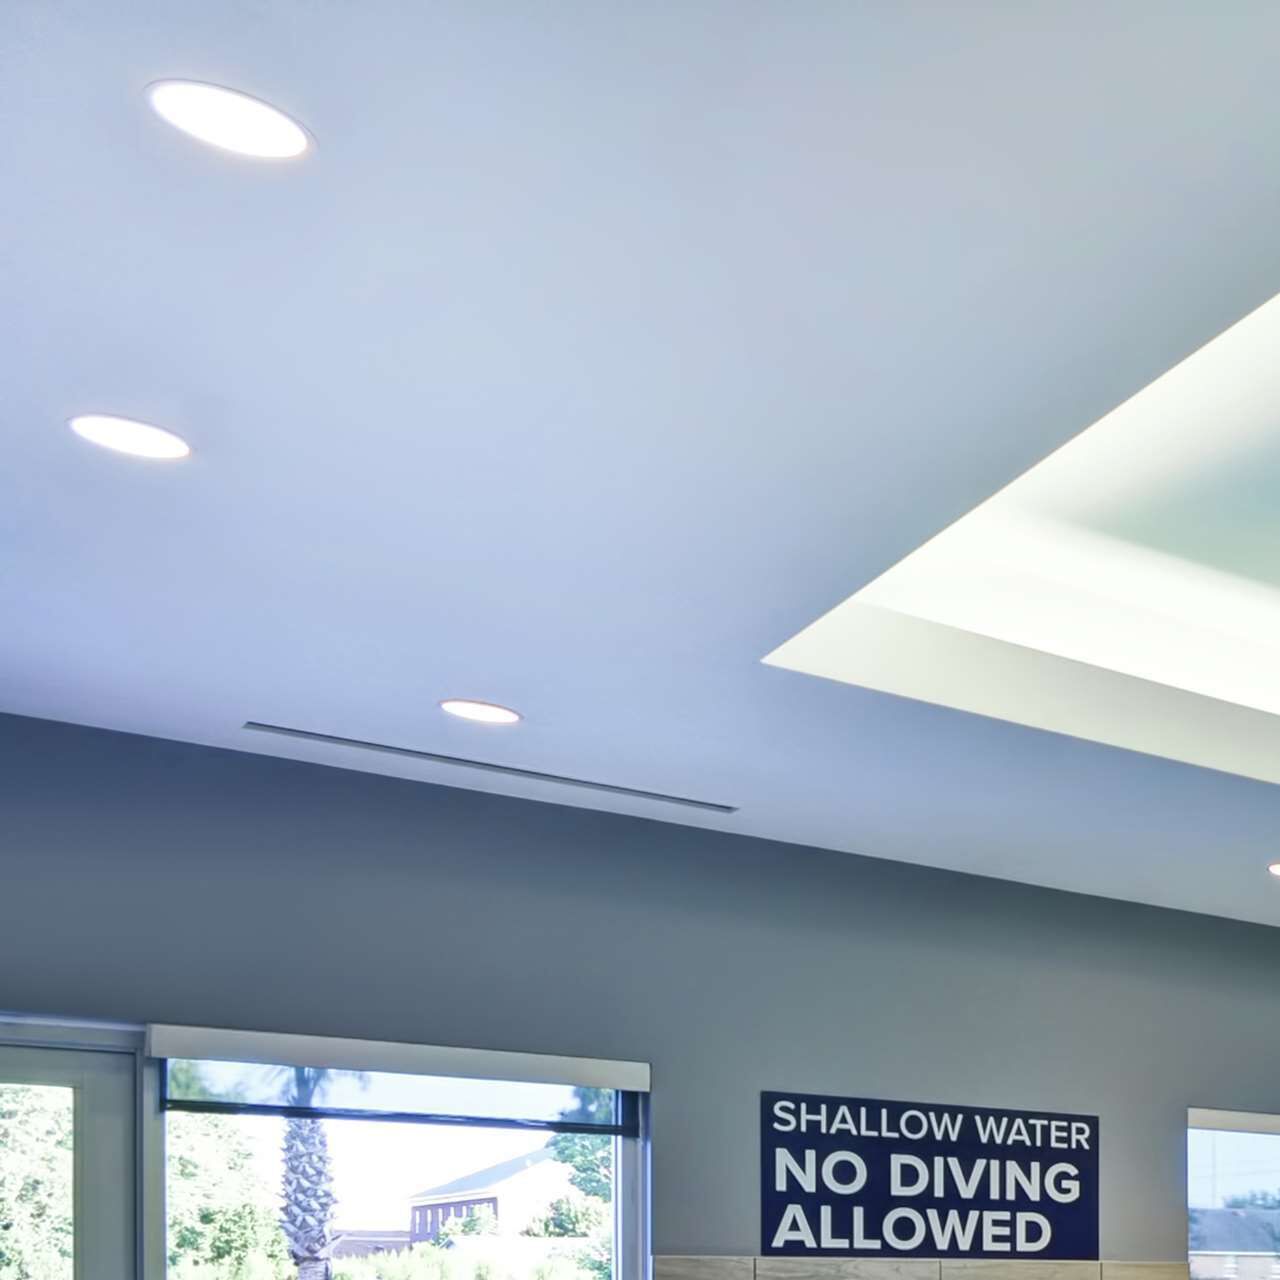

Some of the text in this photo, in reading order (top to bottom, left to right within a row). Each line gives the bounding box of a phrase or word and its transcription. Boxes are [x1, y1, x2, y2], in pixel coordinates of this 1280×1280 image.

[772, 1101, 1090, 1150] SHALLOW WATER
[774, 1147, 1081, 1203] NO DIVING
[771, 1204, 1052, 1252] ALLOWED
